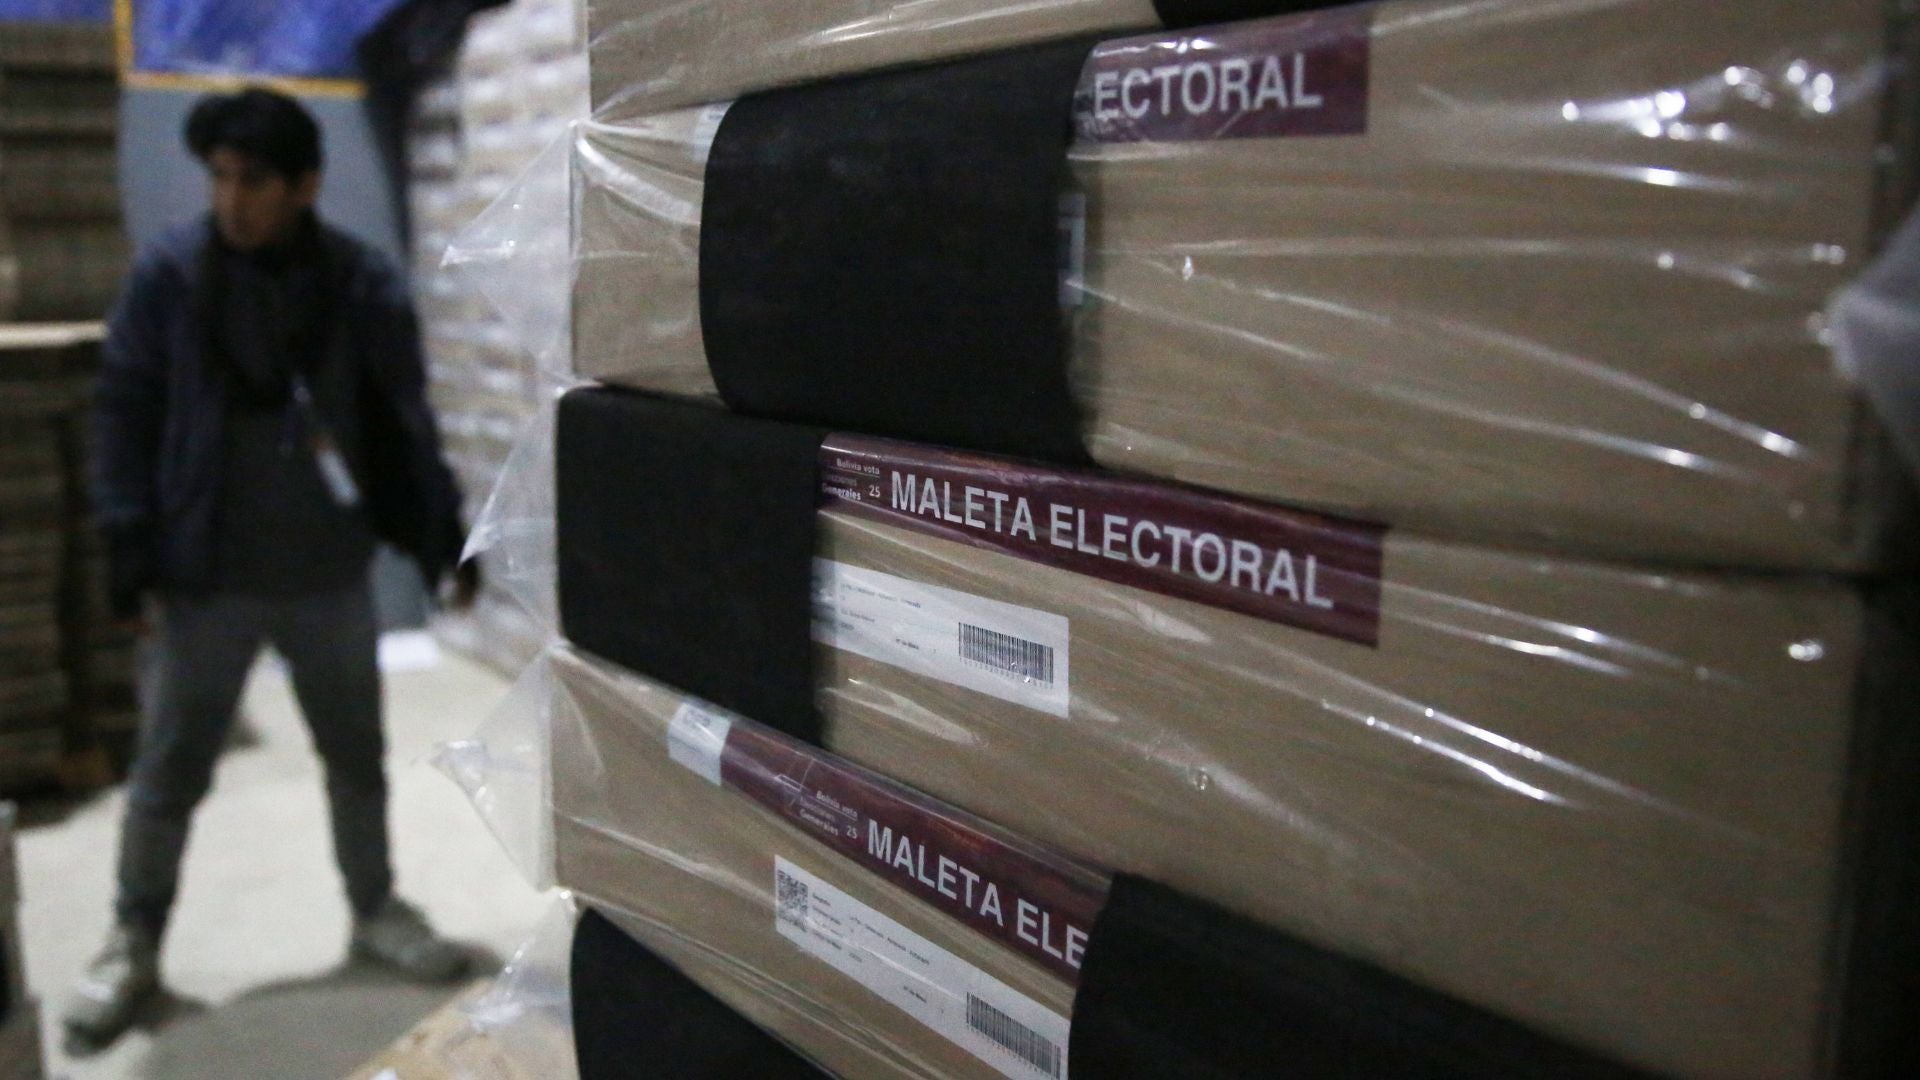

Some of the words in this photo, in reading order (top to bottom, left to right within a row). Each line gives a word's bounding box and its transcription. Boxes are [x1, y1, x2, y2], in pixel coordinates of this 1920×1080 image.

[863, 466, 880, 475] vota
[868, 484, 881, 498] 25
[891, 470, 1037, 542] MALETA
[1049, 503, 1335, 609] ELECTORAL
[846, 824, 858, 839] 25
[868, 818, 1004, 927] MALETA
[1016, 898, 1090, 970] ELE
